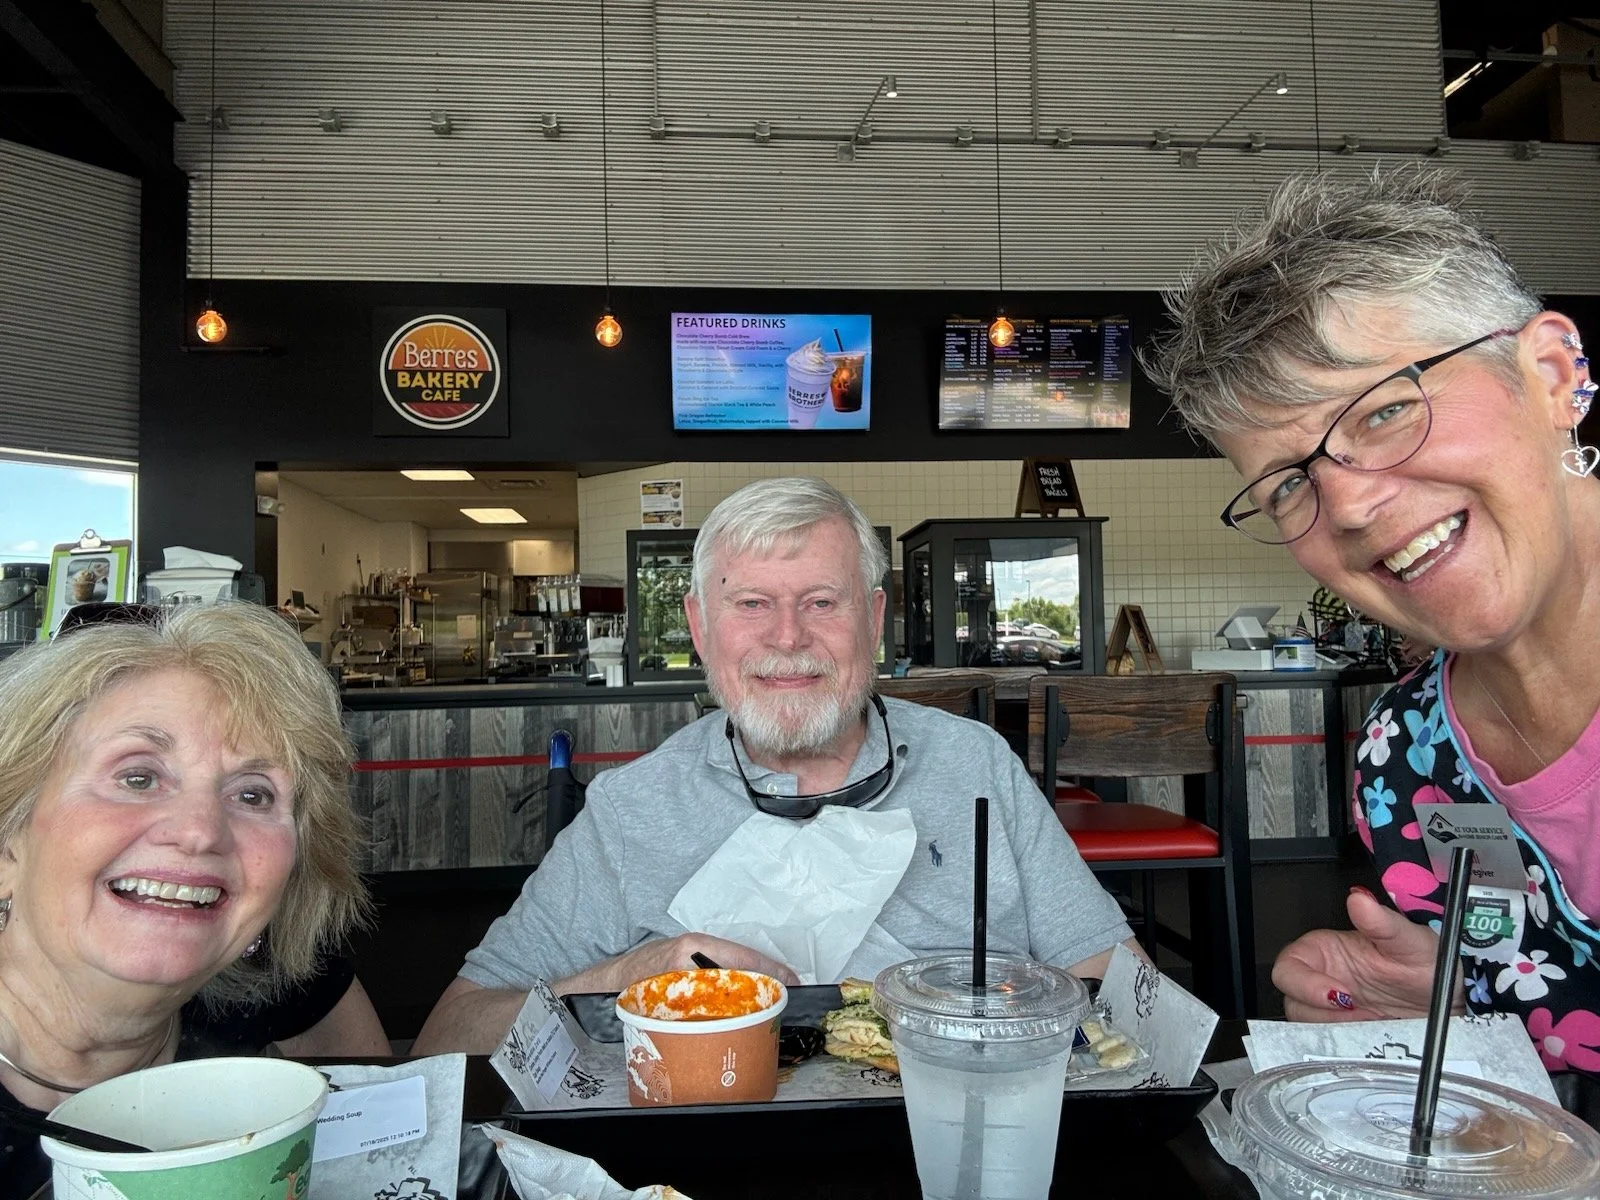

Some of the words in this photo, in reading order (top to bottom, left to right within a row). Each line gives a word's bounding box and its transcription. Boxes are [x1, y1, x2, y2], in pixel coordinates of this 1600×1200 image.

[676, 317, 738, 328] FEATURED
[741, 317, 786, 328] DRINKS
[404, 342, 478, 368] Berres
[397, 372, 483, 388] BAKERY
[421, 389, 461, 401] CAFE
[1472, 869, 1494, 878] egiver
[1466, 915, 1502, 932] 100
[317, 1114, 344, 1124] Wedding
[346, 1110, 363, 1119] Soup
